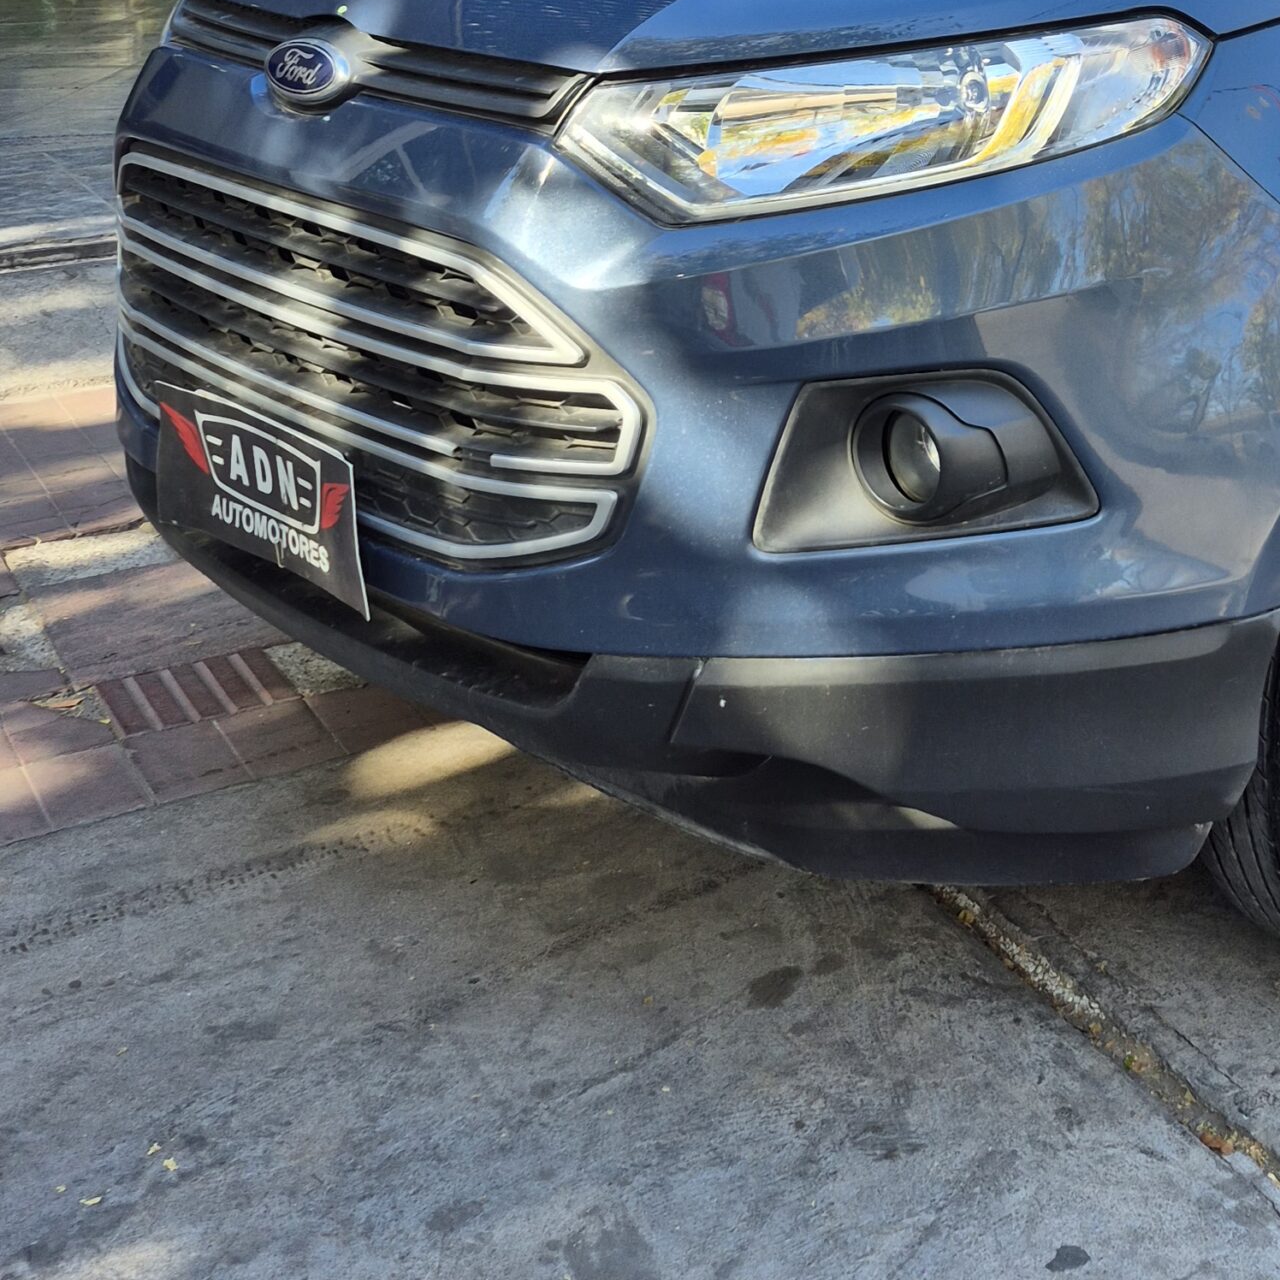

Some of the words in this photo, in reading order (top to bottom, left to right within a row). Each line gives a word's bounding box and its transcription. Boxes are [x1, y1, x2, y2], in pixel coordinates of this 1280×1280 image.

[275, 47, 323, 85] Ford
[229, 434, 299, 511] ADN
[211, 494, 330, 574] AUTOMOTORES
